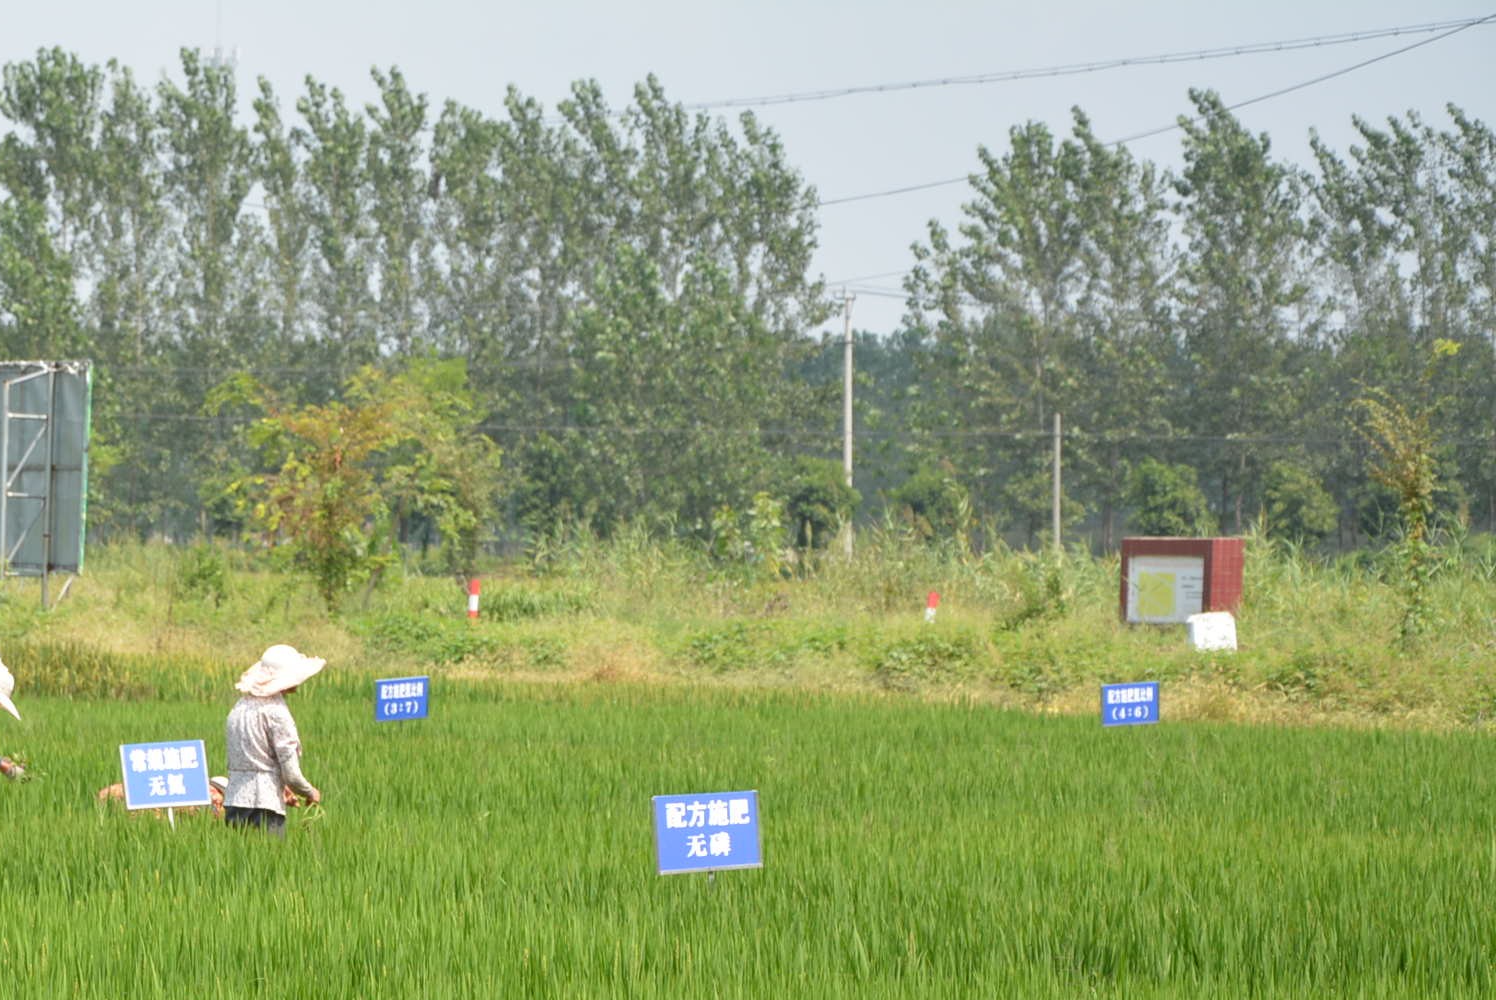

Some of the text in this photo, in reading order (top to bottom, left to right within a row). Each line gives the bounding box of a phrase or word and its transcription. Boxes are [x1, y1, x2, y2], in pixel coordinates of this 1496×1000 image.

[665, 798, 751, 829] 配方施肥
[686, 831, 732, 858] 无磷
